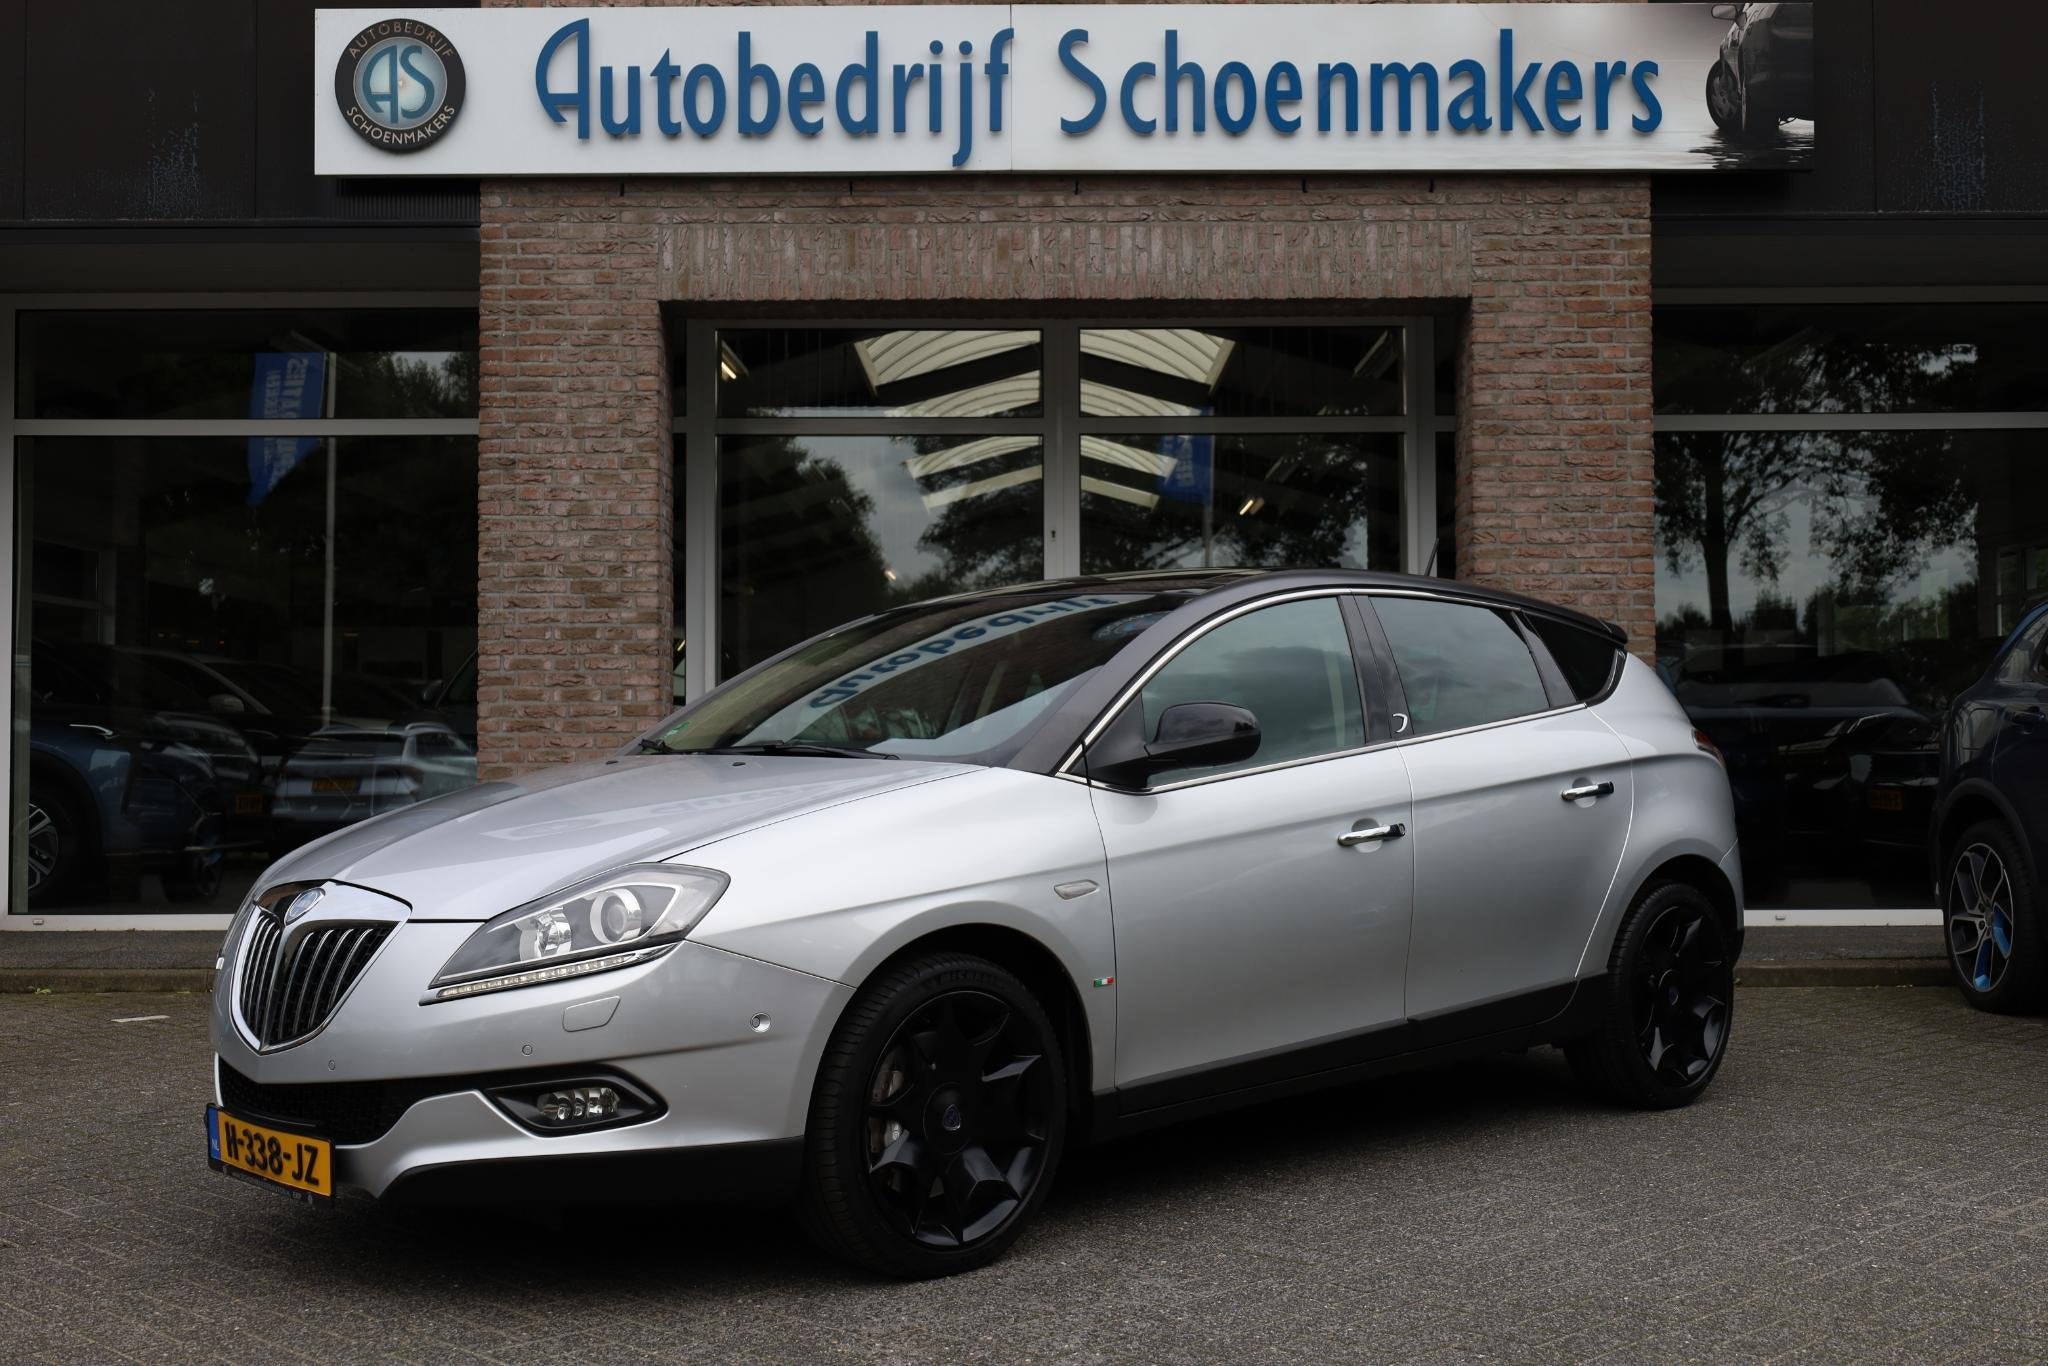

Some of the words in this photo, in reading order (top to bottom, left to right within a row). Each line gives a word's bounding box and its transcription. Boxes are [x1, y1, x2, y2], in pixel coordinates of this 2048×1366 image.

[349, 21, 455, 59] AUTOBEDRIJF
[362, 44, 435, 125] AS
[536, 17, 1014, 167] Autobedrijf
[1058, 28, 1664, 135] Schoenmakers
[346, 104, 456, 145] SCHOENMAKERS
[224, 1121, 320, 1187] H-338-JZ
